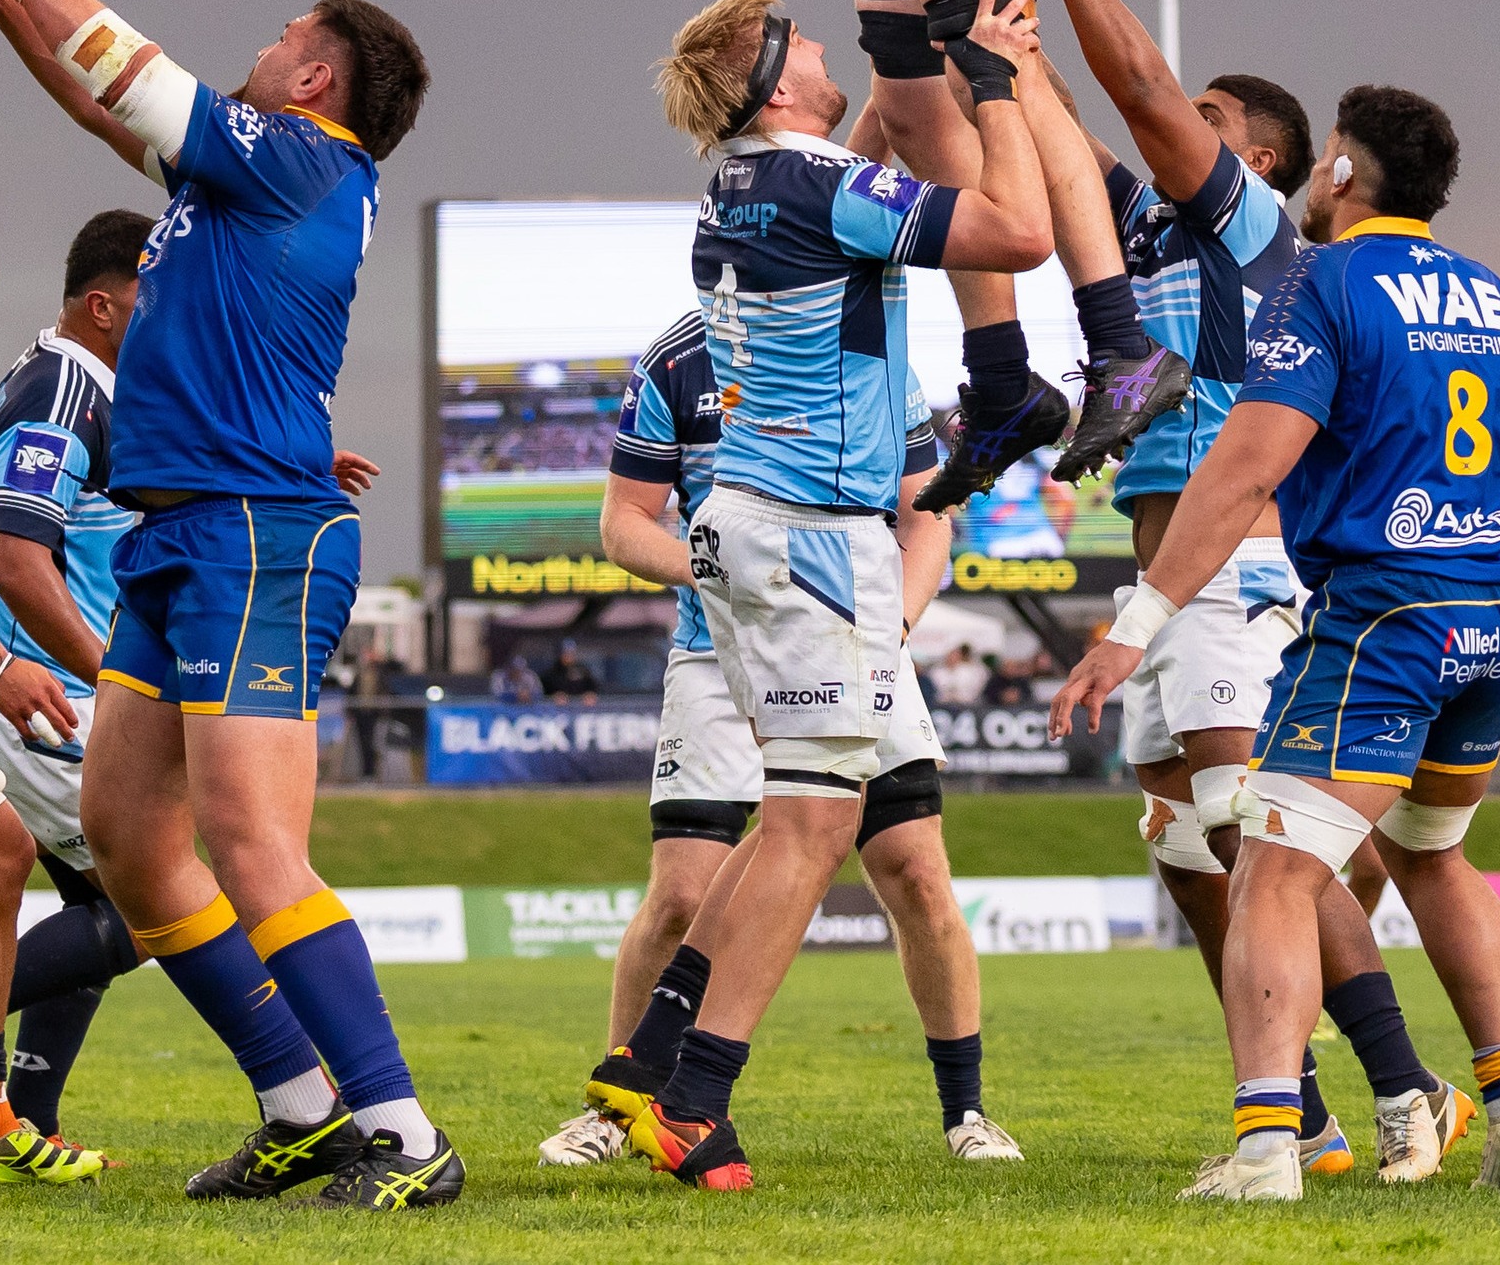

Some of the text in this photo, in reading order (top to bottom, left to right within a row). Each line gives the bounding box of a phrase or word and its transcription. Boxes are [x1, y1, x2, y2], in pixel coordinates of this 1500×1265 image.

[706, 263, 754, 368] 4
[1248, 334, 1316, 367] rezzy
[1263, 356, 1295, 372] Card
[1444, 369, 1493, 476] 8
[1443, 626, 1500, 655] Allied
[180, 659, 220, 675] Media
[870, 669, 896, 683] ARC
[248, 683, 295, 693] GILBERT
[764, 689, 839, 705] AIRZONE
[441, 714, 570, 755] BLACK
[660, 738, 683, 752] ARC
[1282, 741, 1324, 751] GILBERT
[505, 889, 640, 922] TACKLE
[802, 902, 889, 944] ORKS
[986, 909, 1094, 952] fern
